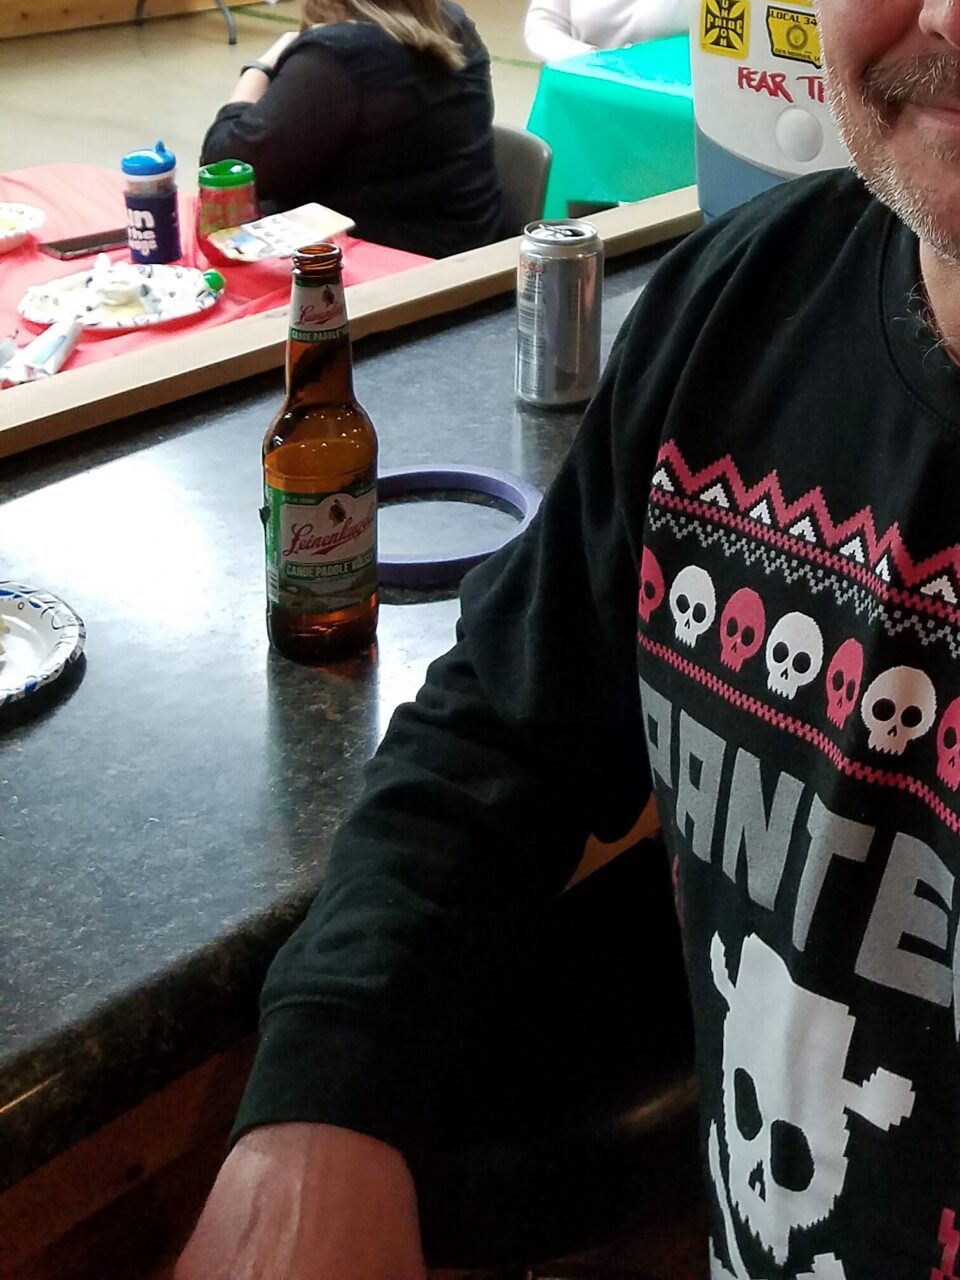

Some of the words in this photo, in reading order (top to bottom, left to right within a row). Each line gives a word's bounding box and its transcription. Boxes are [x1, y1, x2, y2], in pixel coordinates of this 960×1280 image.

[720, 0, 729, 47] UNION
[770, 10, 801, 24] LOCAL
[803, 17, 818, 26] 34
[738, 66, 794, 104] FEAR
